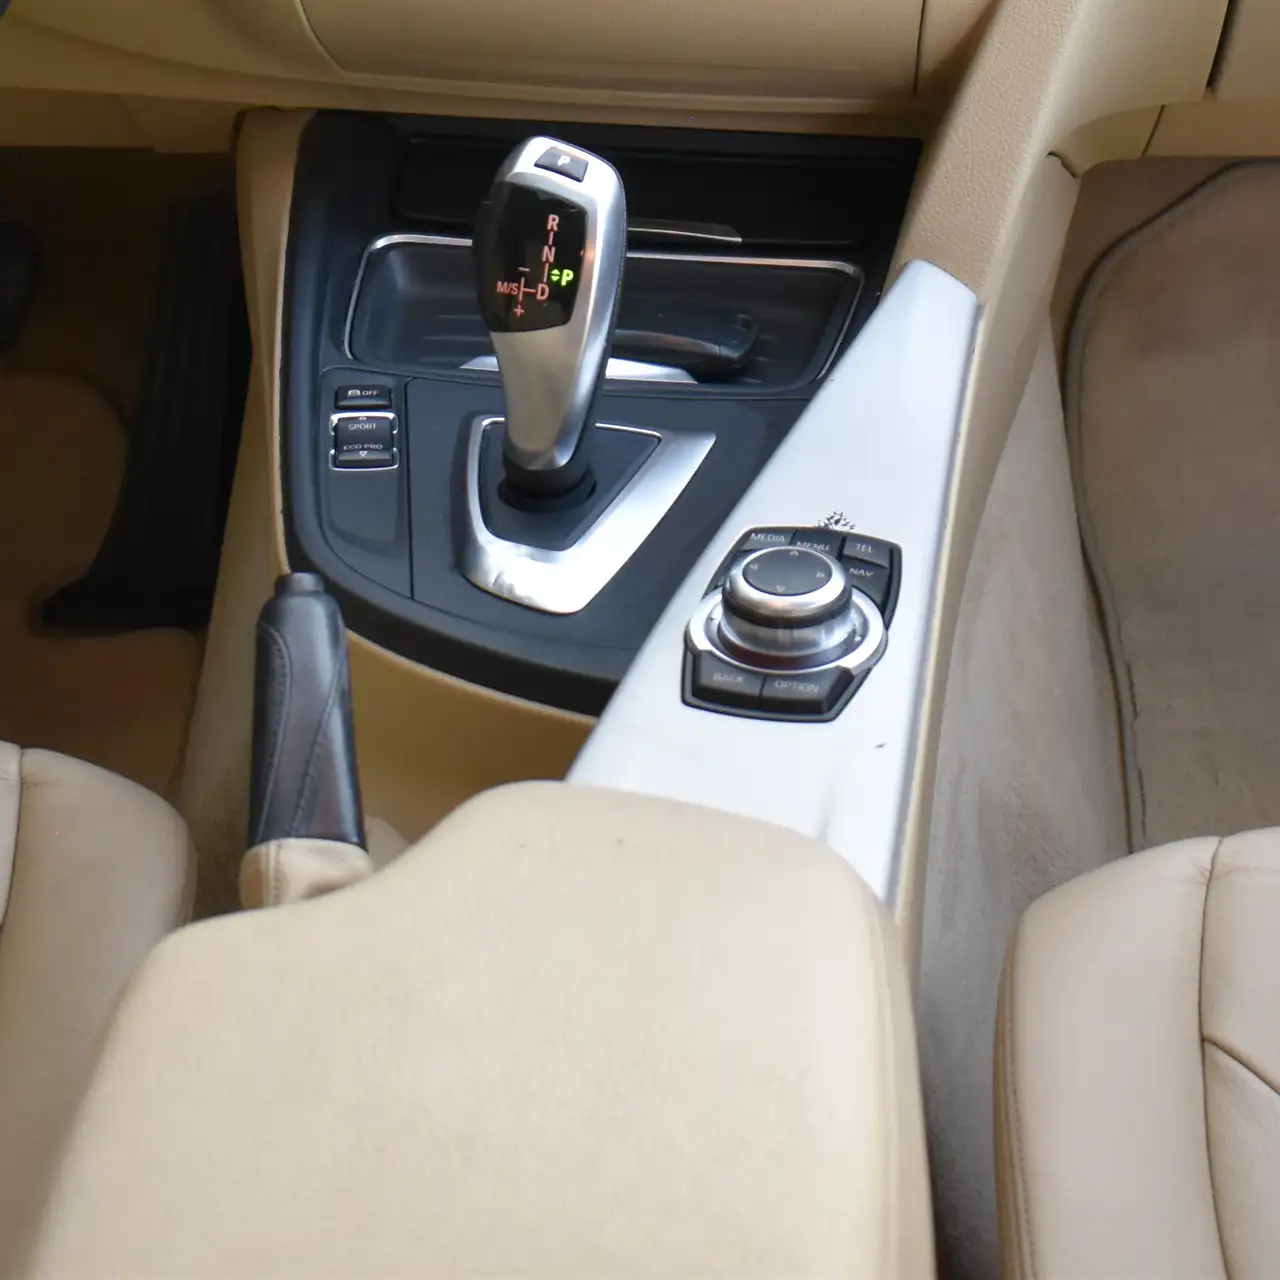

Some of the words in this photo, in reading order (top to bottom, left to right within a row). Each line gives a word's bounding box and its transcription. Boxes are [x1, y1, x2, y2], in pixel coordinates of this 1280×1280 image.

[557, 155, 571, 166] P
[547, 214, 559, 231] R
[542, 246, 555, 262] N
[561, 269, 574, 286] P
[496, 281, 518, 295] M/S
[536, 284, 549, 300] D
[348, 423, 377, 431] SPORT
[750, 533, 785, 543] MEDIA
[796, 541, 830, 551] MENU
[855, 543, 874, 553] TEL
[848, 567, 874, 577] NAV
[712, 672, 745, 684] BACK
[774, 679, 820, 693] OPTION
